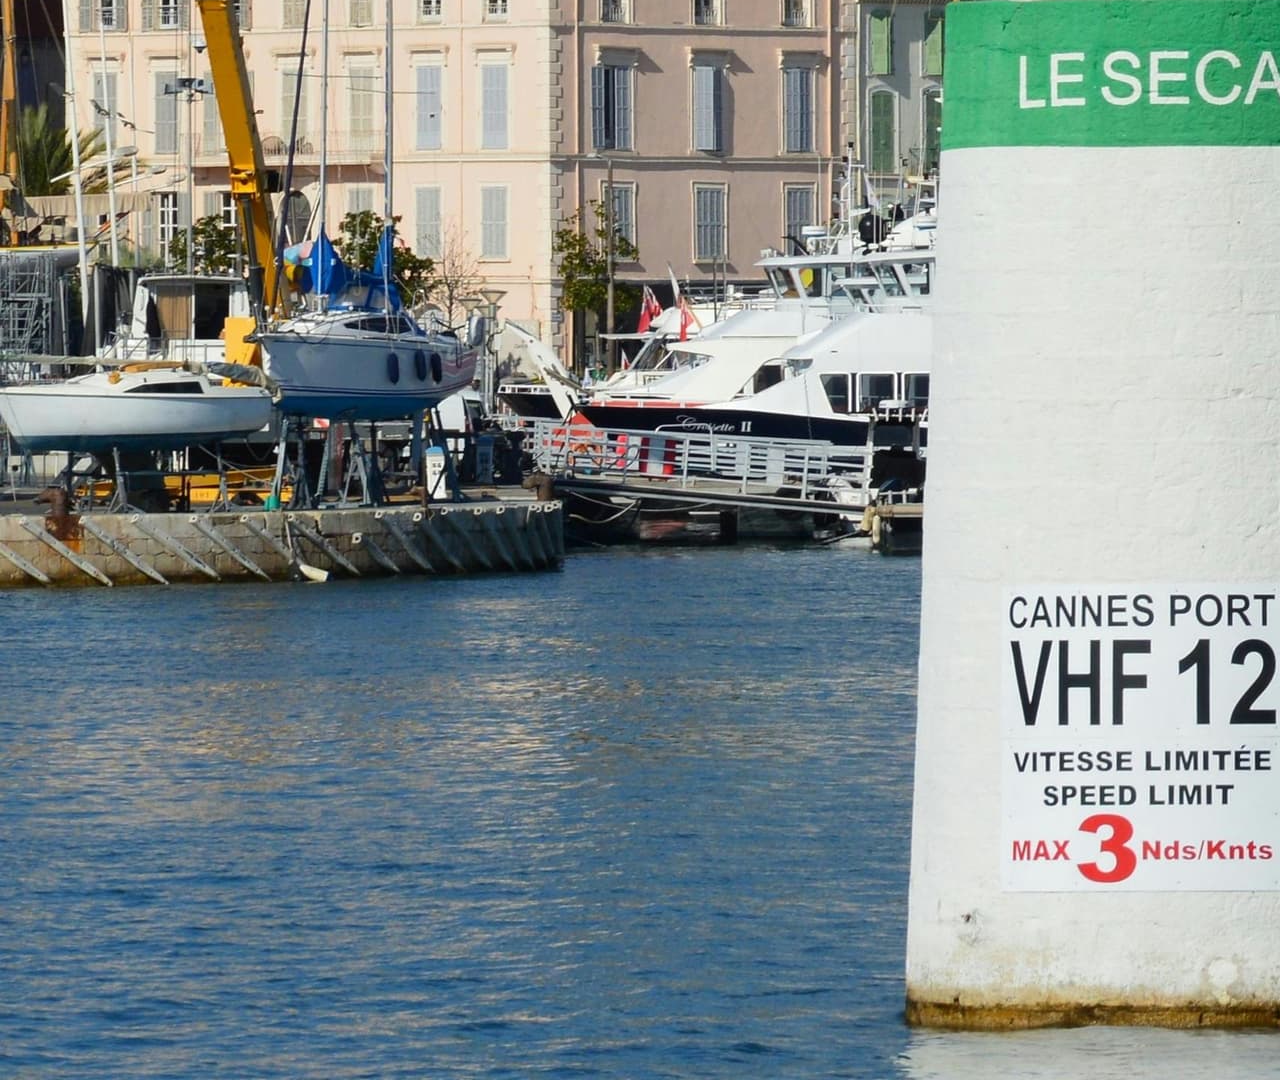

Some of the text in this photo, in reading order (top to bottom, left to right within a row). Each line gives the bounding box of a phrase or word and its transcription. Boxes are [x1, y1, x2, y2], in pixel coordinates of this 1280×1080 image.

[1018, 52, 1086, 109] LE
[1009, 594, 1276, 629] CANNES PORT
[1010, 638, 1277, 726] VHF 12
[1014, 745, 1272, 773] VITESSE LIMITÉE
[1043, 784, 1235, 806] SPEED LIMIT
[1012, 814, 1273, 883] MAX 3 Nds/Knts
